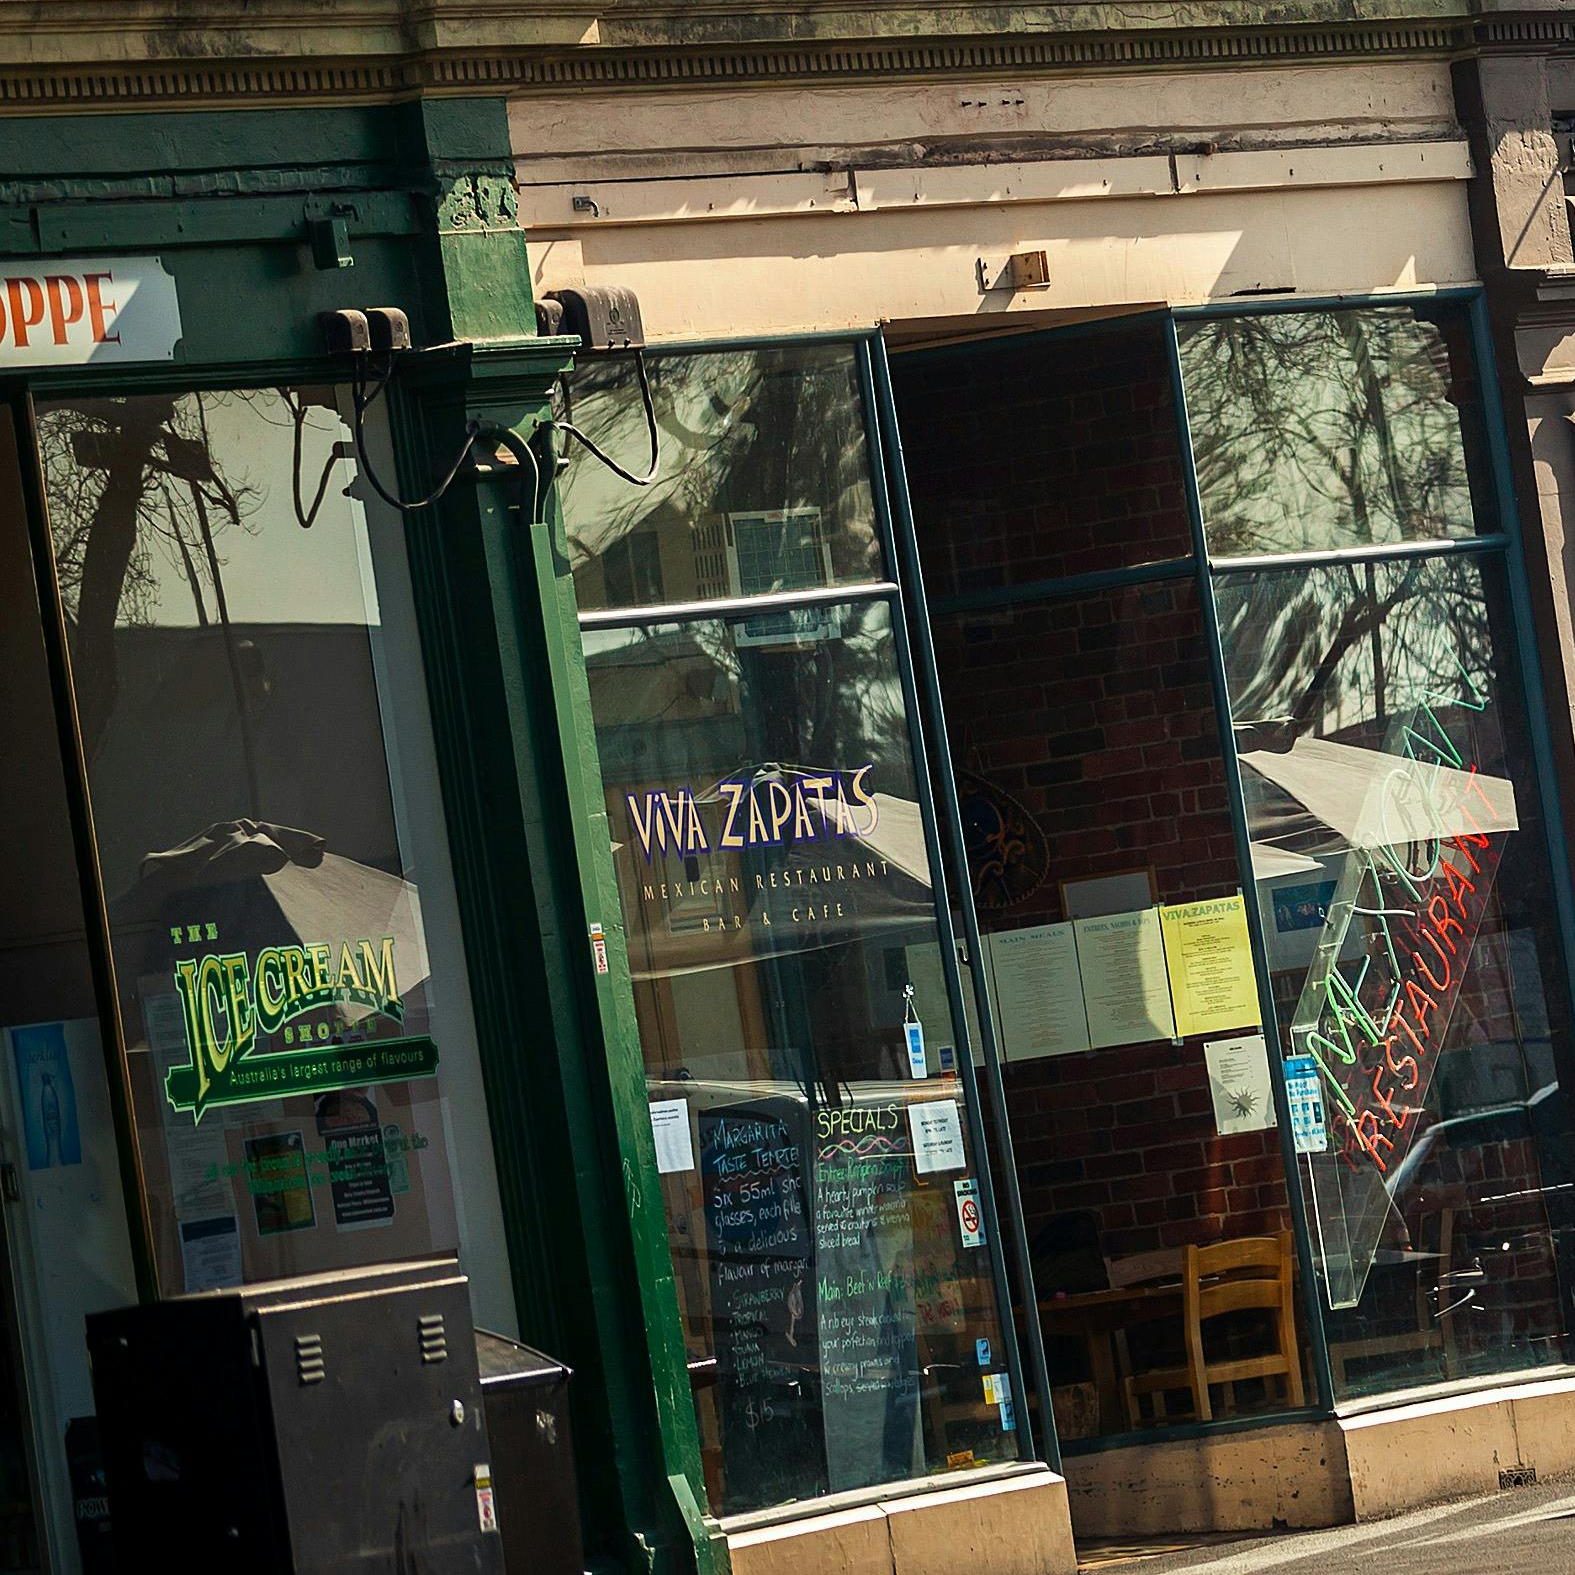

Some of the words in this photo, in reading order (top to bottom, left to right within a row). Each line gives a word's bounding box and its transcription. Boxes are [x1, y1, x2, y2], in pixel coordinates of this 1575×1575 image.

[718, 764, 879, 850] ZAPATAS
[644, 878, 739, 901] MEXICAN
[756, 861, 888, 889] RESTAURANT
[1307, 629, 1485, 1116] MEXICAN
[703, 916, 742, 932] BAR
[763, 912, 771, 925] &
[792, 903, 843, 923] CAFE
[1190, 901, 1241, 918] ZAPATAS
[170, 923, 218, 944] THE
[1353, 764, 1500, 1172] RESTAURANT
[176, 952, 254, 1102] ICE
[257, 937, 404, 1031] CREAM
[229, 1066, 287, 1086] Australia's
[289, 1060, 328, 1079] largest
[331, 1057, 362, 1074] range
[366, 1052, 376, 1067] of
[381, 1049, 424, 1067] flavours
[713, 1118, 787, 1152] MARGARITA
[817, 1104, 898, 1138] SPECIALS
[713, 1153, 748, 1177] TASTE
[750, 1228, 797, 1252] delicious
[745, 1396, 774, 1430] $15
